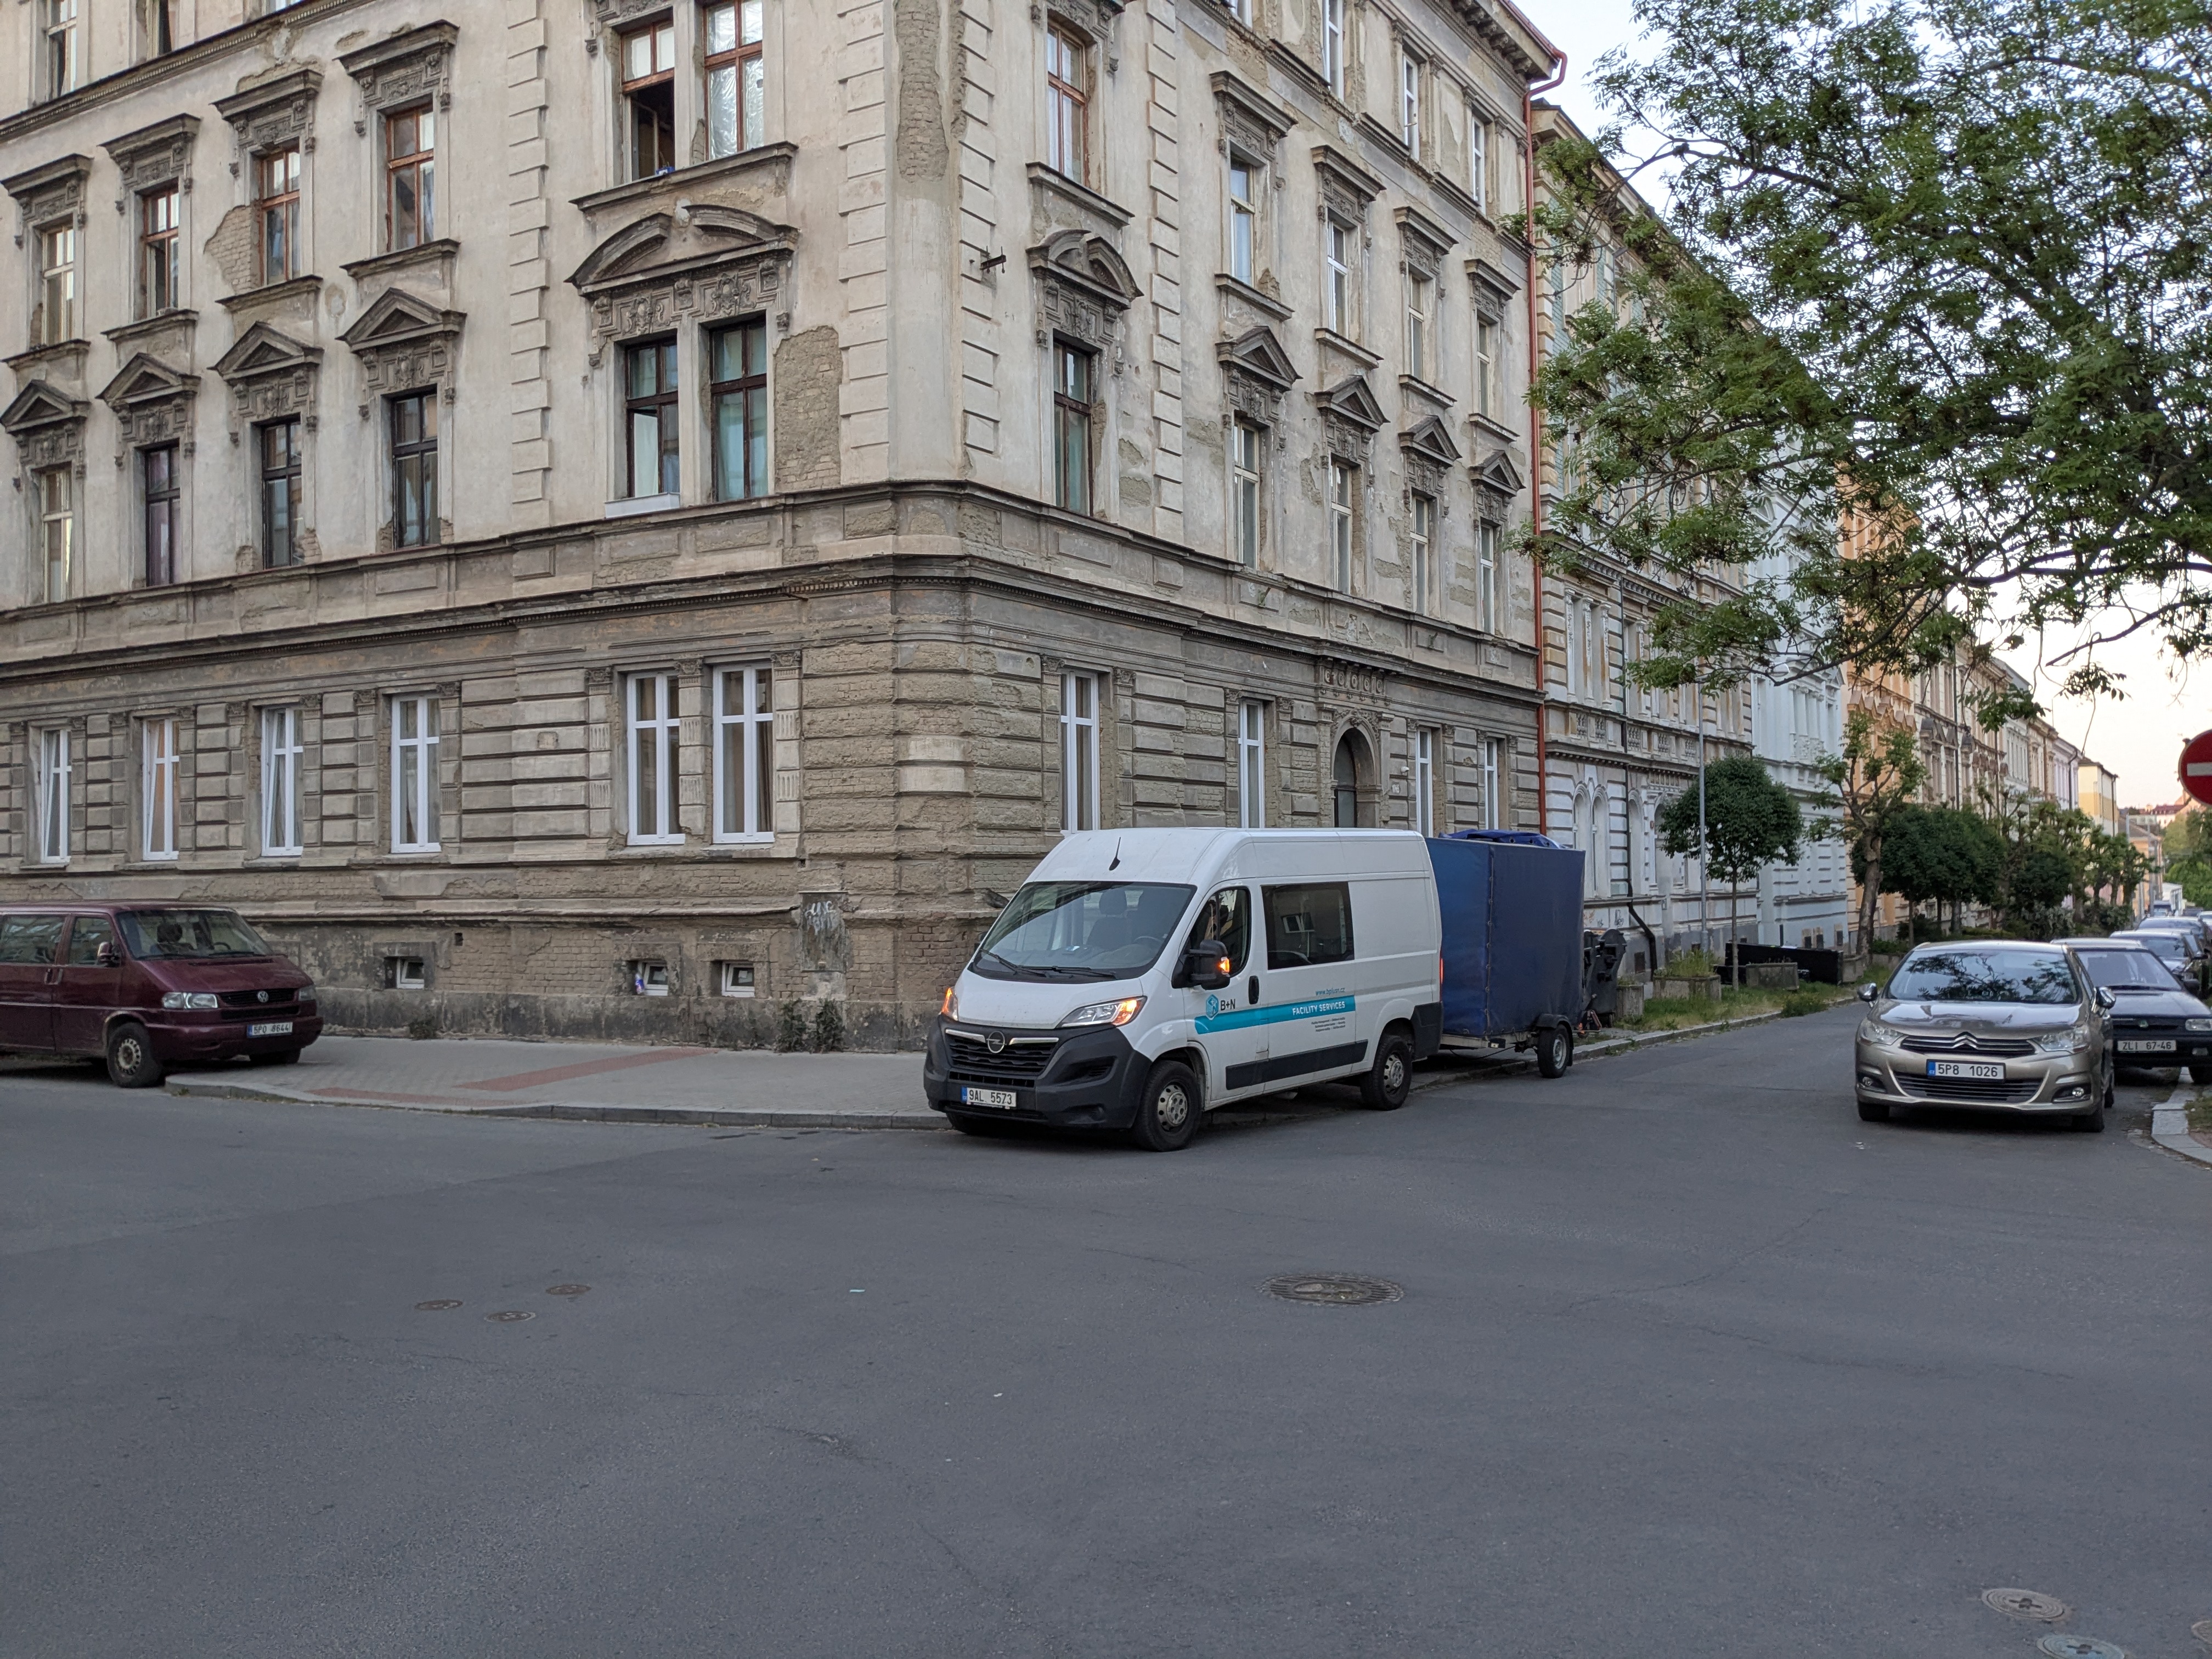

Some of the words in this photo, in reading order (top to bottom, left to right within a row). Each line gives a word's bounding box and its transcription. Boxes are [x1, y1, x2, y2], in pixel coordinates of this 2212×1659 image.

[1220, 998, 1235, 1011] B+N
[1292, 1005, 1318, 1015] FACILITY
[1319, 1001, 1345, 1012] SERVICES
[1938, 1064, 1960, 1075] 5P8
[1969, 1065, 1998, 1077] 1026
[969, 1090, 984, 1102] 9AL
[991, 1092, 1012, 1105] 5573
